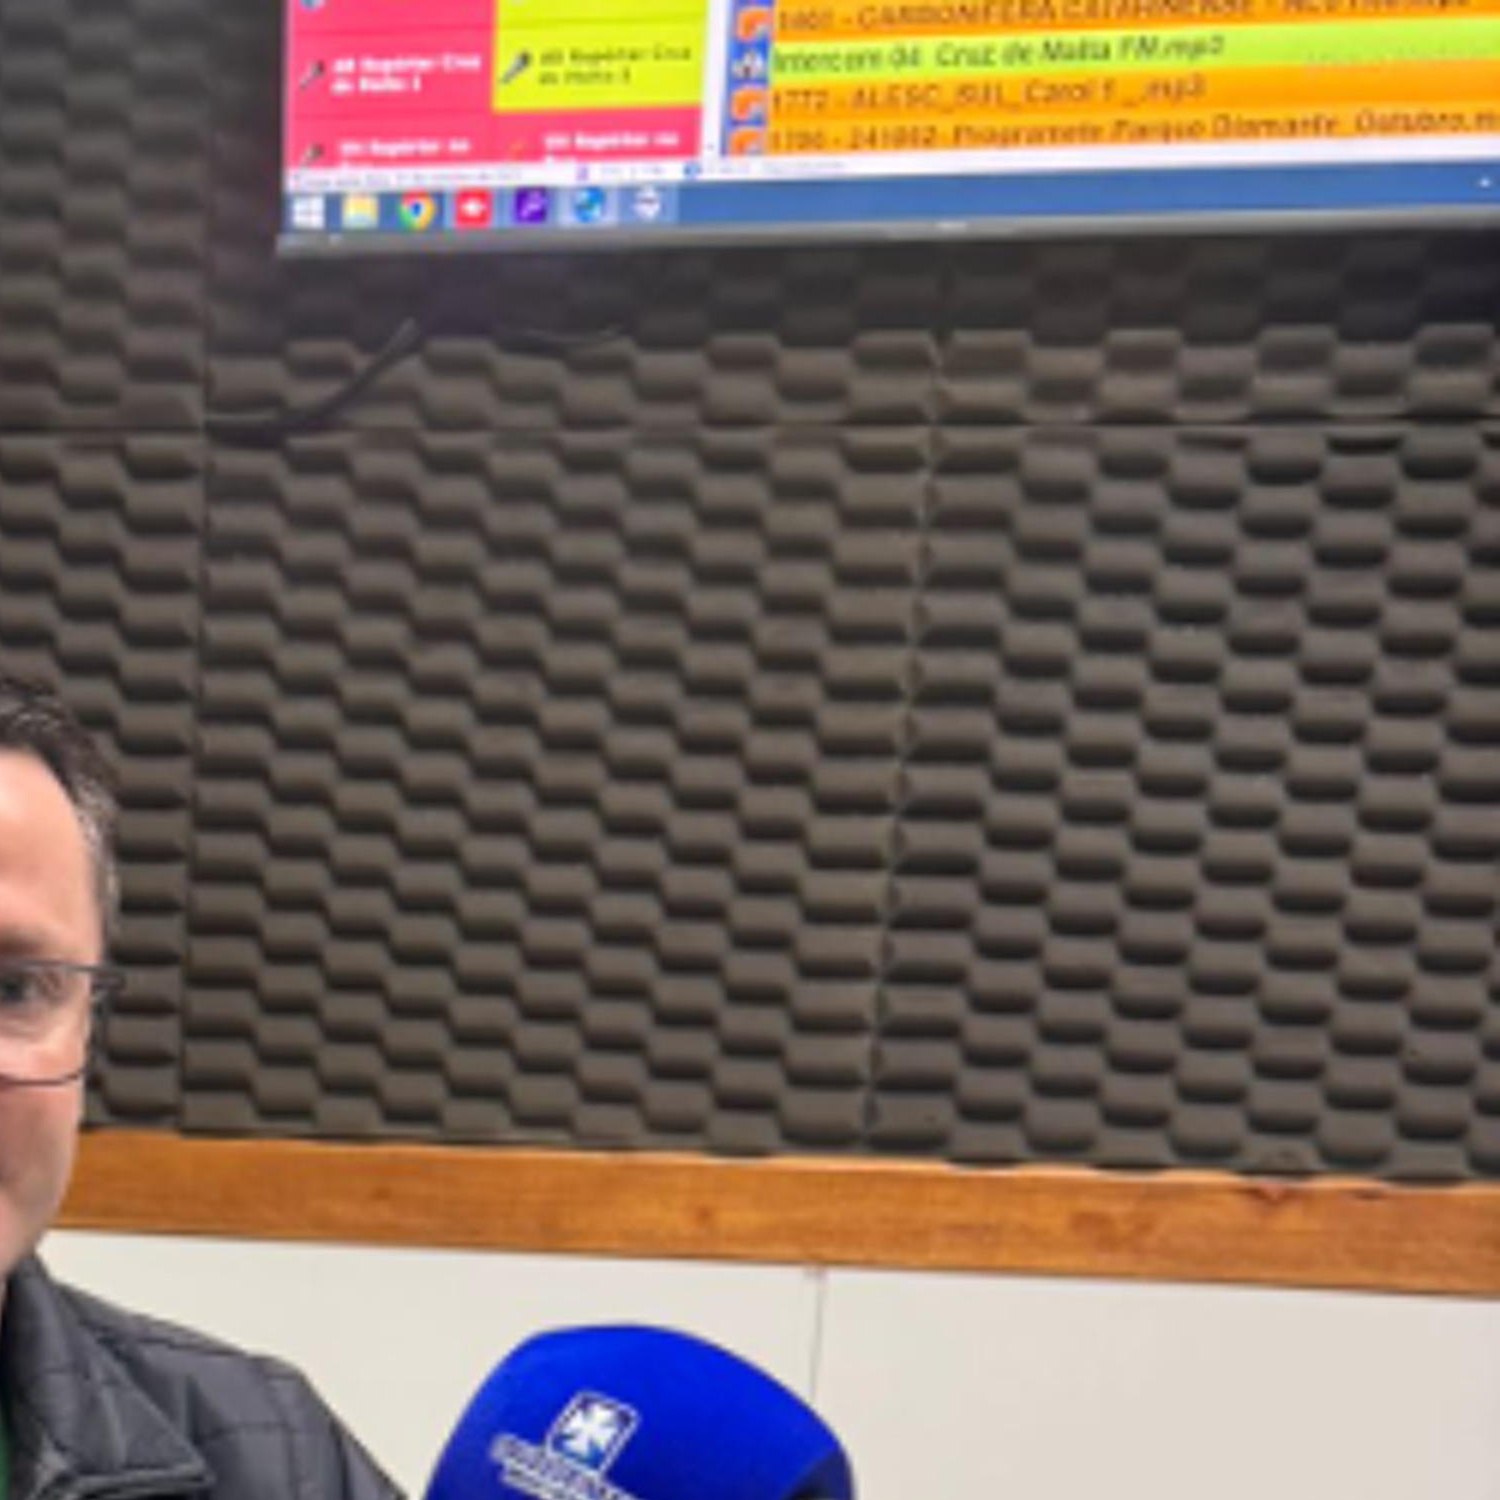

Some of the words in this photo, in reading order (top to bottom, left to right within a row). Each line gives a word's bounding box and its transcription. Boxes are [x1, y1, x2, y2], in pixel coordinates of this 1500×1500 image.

[935, 42, 996, 68] Cruz
[1002, 41, 1034, 65] de
[1043, 36, 1110, 63] Malta
